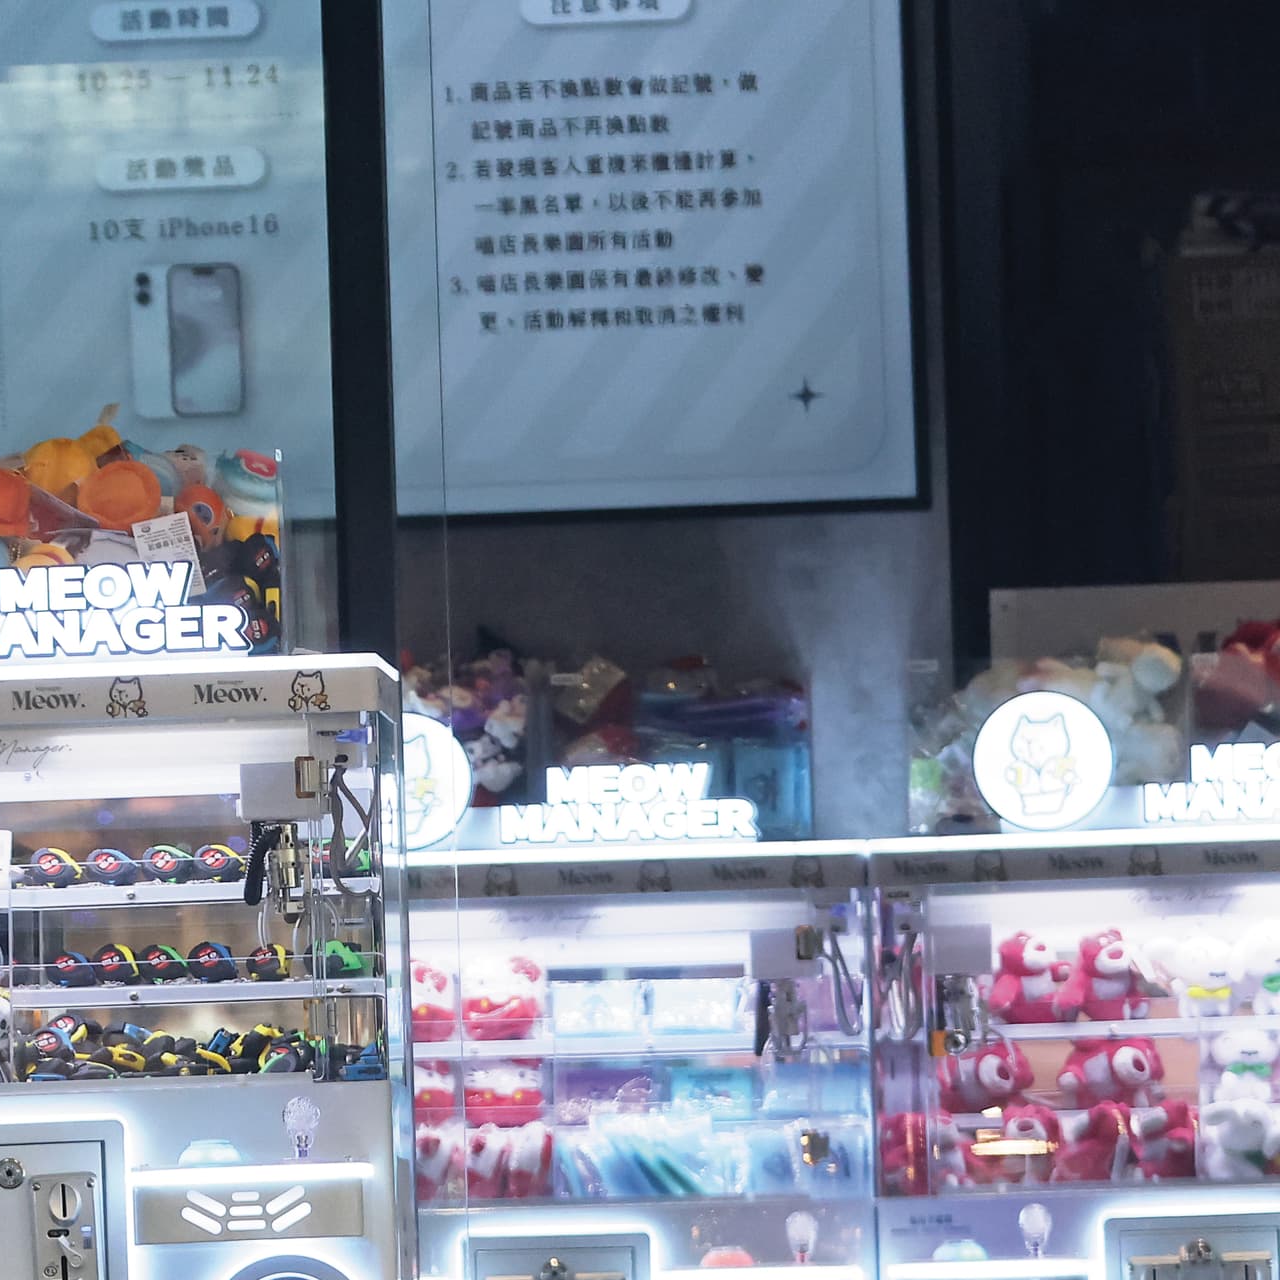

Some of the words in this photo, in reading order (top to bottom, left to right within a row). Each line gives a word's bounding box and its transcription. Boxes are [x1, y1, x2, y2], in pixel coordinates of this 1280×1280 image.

[89, 218, 145, 243] 10支
[158, 212, 280, 239] iPhone16
[545, 762, 711, 804] MEOW
[500, 797, 759, 844] MANAGER
